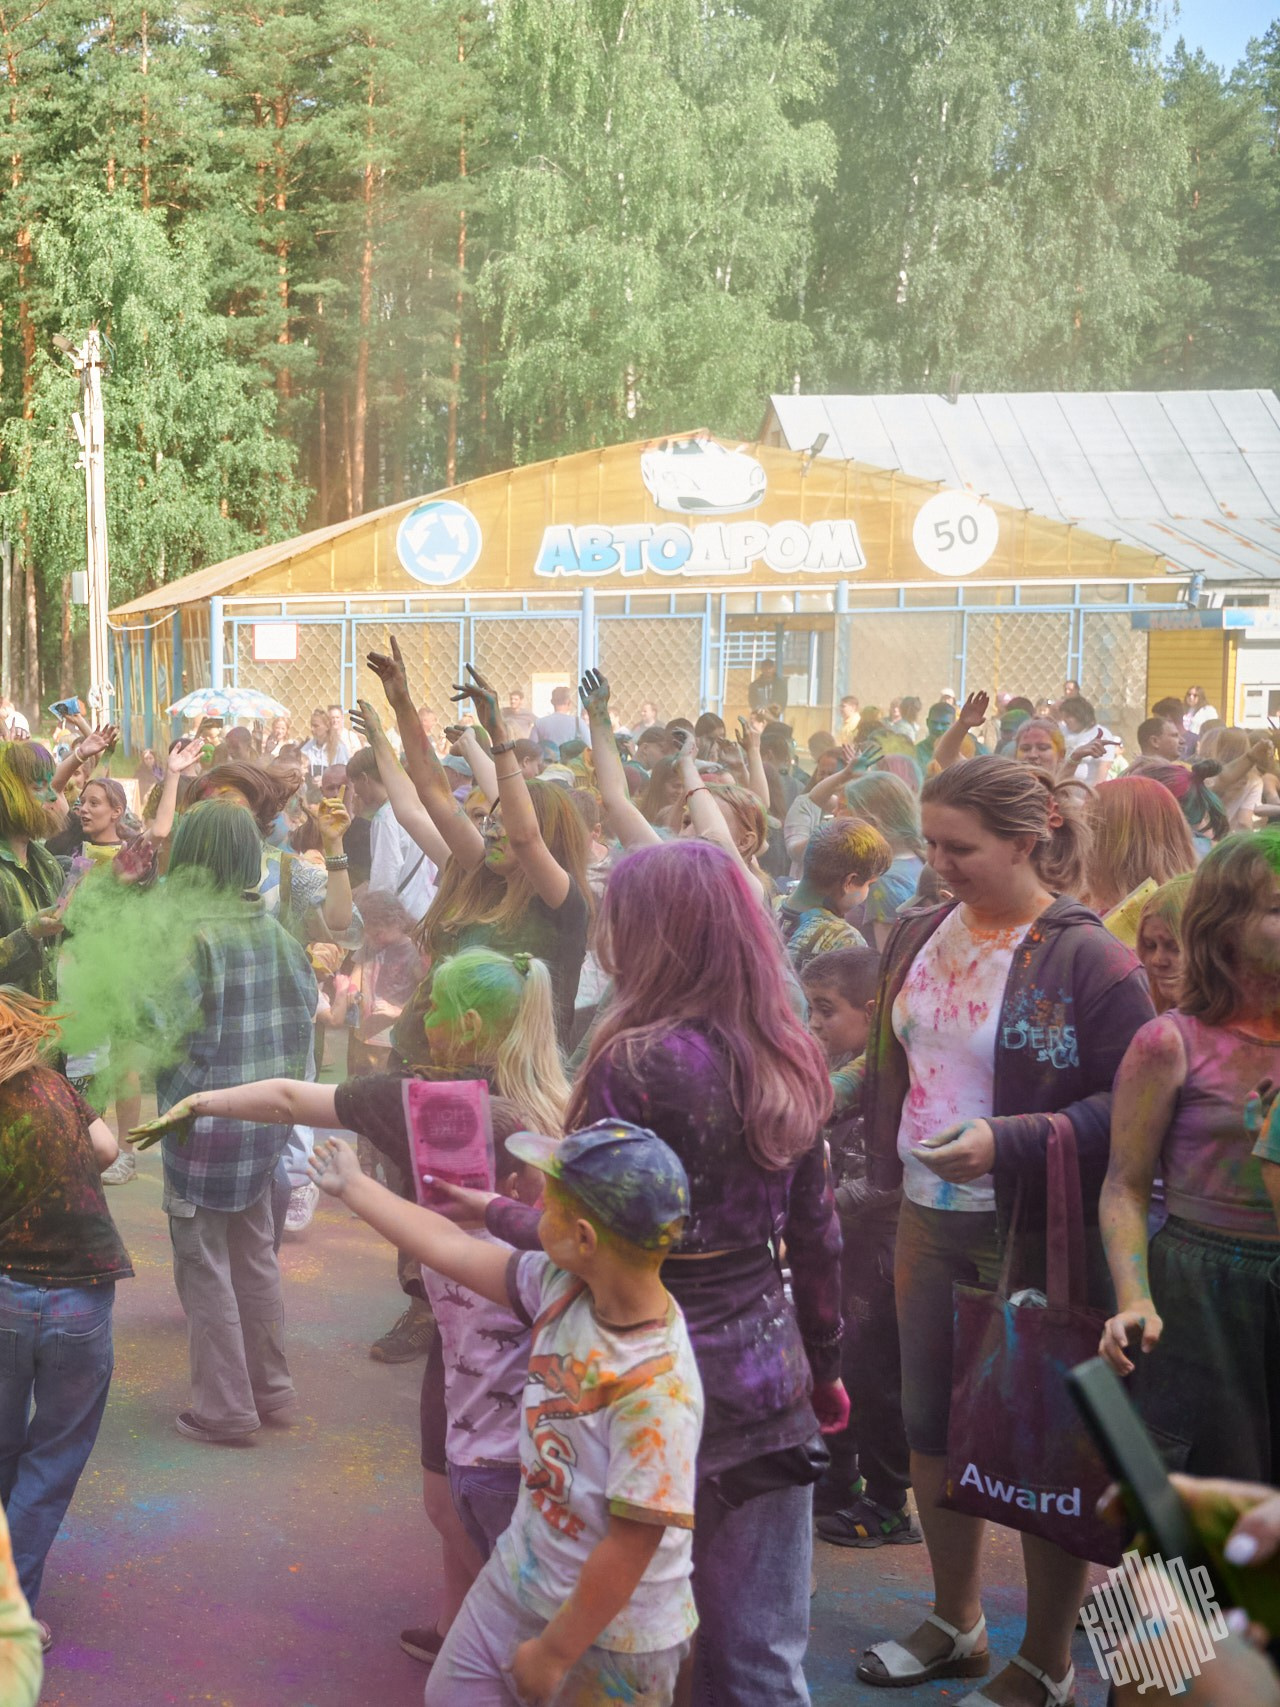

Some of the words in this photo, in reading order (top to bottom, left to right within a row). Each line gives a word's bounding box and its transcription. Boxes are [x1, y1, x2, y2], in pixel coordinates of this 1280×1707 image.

[535, 520, 866, 576] АВТОДРОМ
[933, 514, 979, 552] 50
[959, 1463, 1081, 1517] Award
